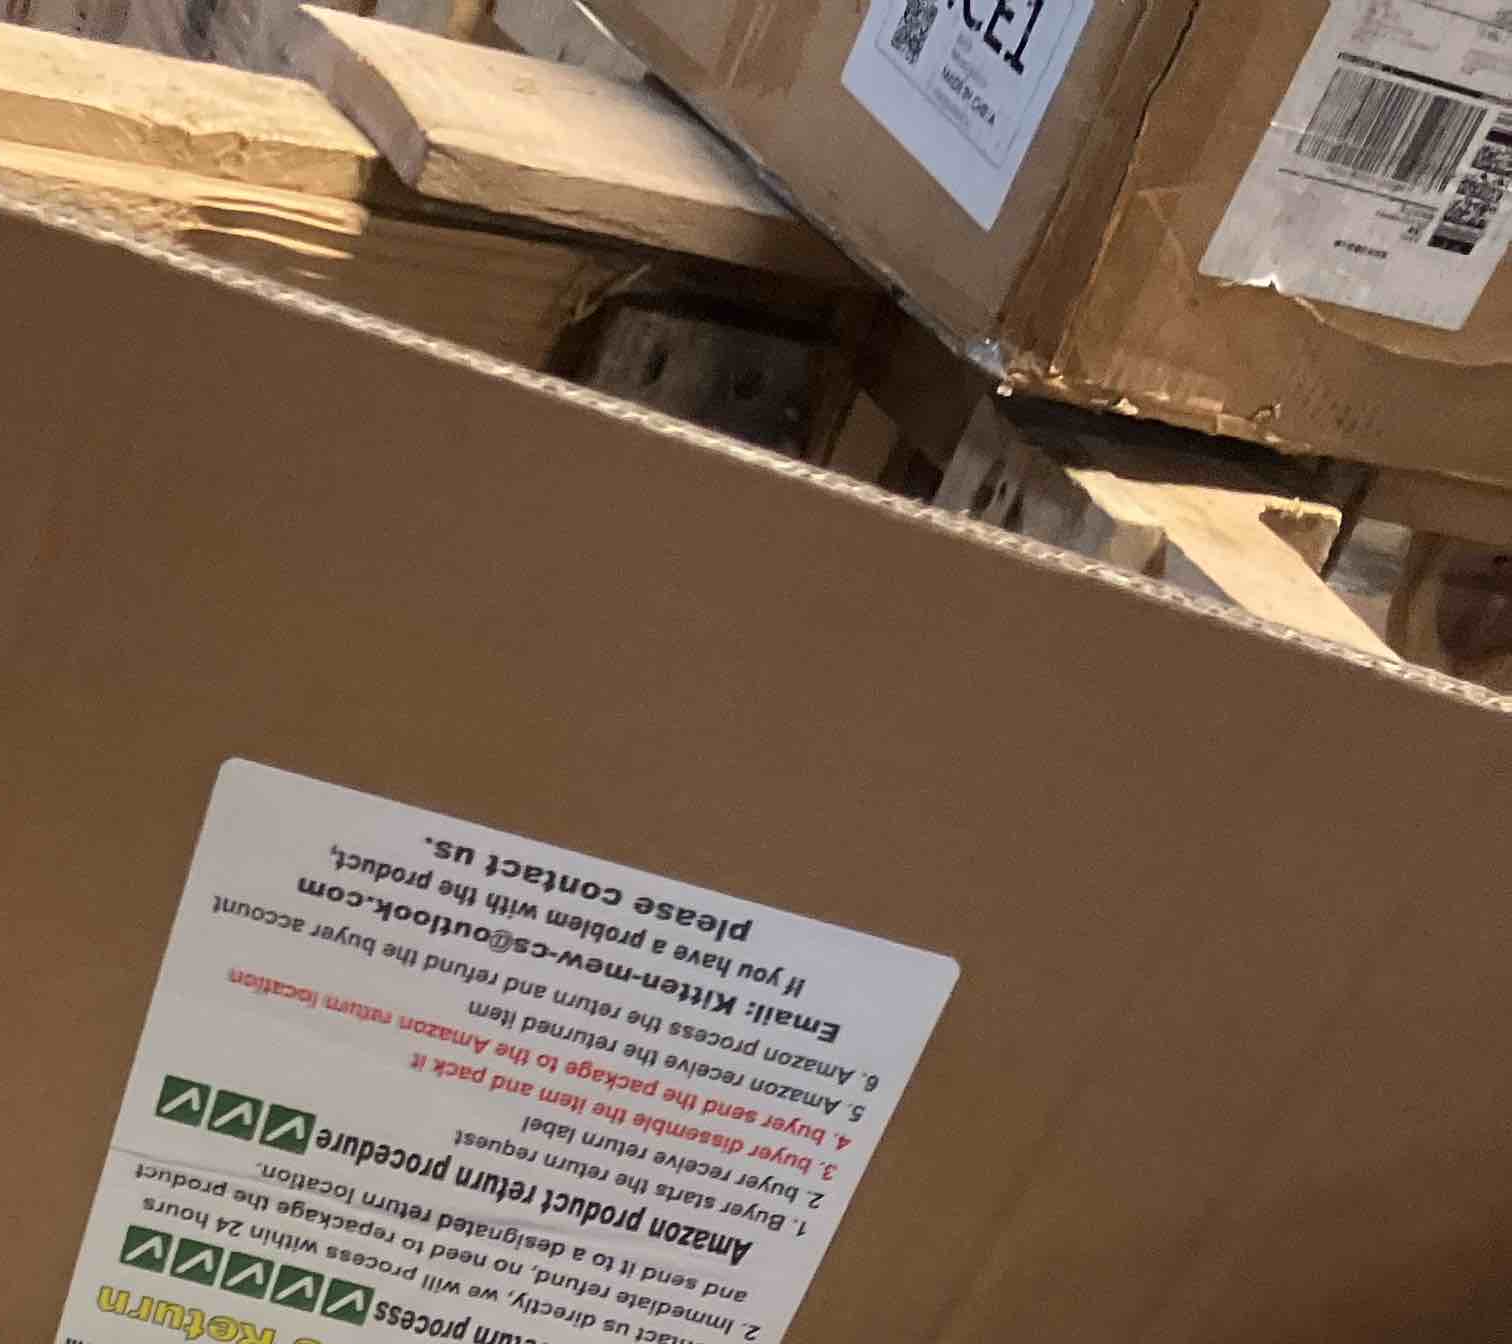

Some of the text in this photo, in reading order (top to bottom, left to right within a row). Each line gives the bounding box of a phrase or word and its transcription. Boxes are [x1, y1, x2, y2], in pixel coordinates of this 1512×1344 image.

[424, 837, 752, 941] please contact us.
[330, 844, 805, 998] If you have a problem with the product,
[297, 877, 840, 1043] Email: Kitten-mew-cs@outlook.com
[212, 895, 878, 1091] 6. Amazon process the return and refund the buyer account
[399, 1016, 490, 1054] Amazon
[468, 1000, 865, 1121] 5. Amazon receive the returned item
[494, 1042, 530, 1066] the
[536, 1054, 558, 1073] to
[565, 1060, 659, 1095] package
[410, 1053, 837, 1180] 3. buyer dissemble the item and pack it
[663, 1088, 697, 1110] the
[700, 1099, 757, 1122] send
[760, 1115, 826, 1145] buyer
[834, 1133, 851, 1150] 4.
[520, 1116, 824, 1208] 2. buyer receive return label
[315, 1128, 753, 1265] Amazon product return procedure
[454, 1129, 806, 1236] 1. Buyer starts the return request
[143, 1197, 208, 1228] hours
[216, 1217, 243, 1236] 24
[250, 1225, 316, 1253] within
[256, 1163, 747, 1302] and send it to a designated return location.
[135, 1163, 760, 1340] 2. Immediate refund, no need to repackage the product
[326, 1246, 417, 1280] process
[421, 1274, 460, 1294] will
[467, 1285, 497, 1301] we
[373, 1300, 471, 1340] process
[508, 1290, 596, 1328] directly,
[602, 1319, 629, 1335] us
